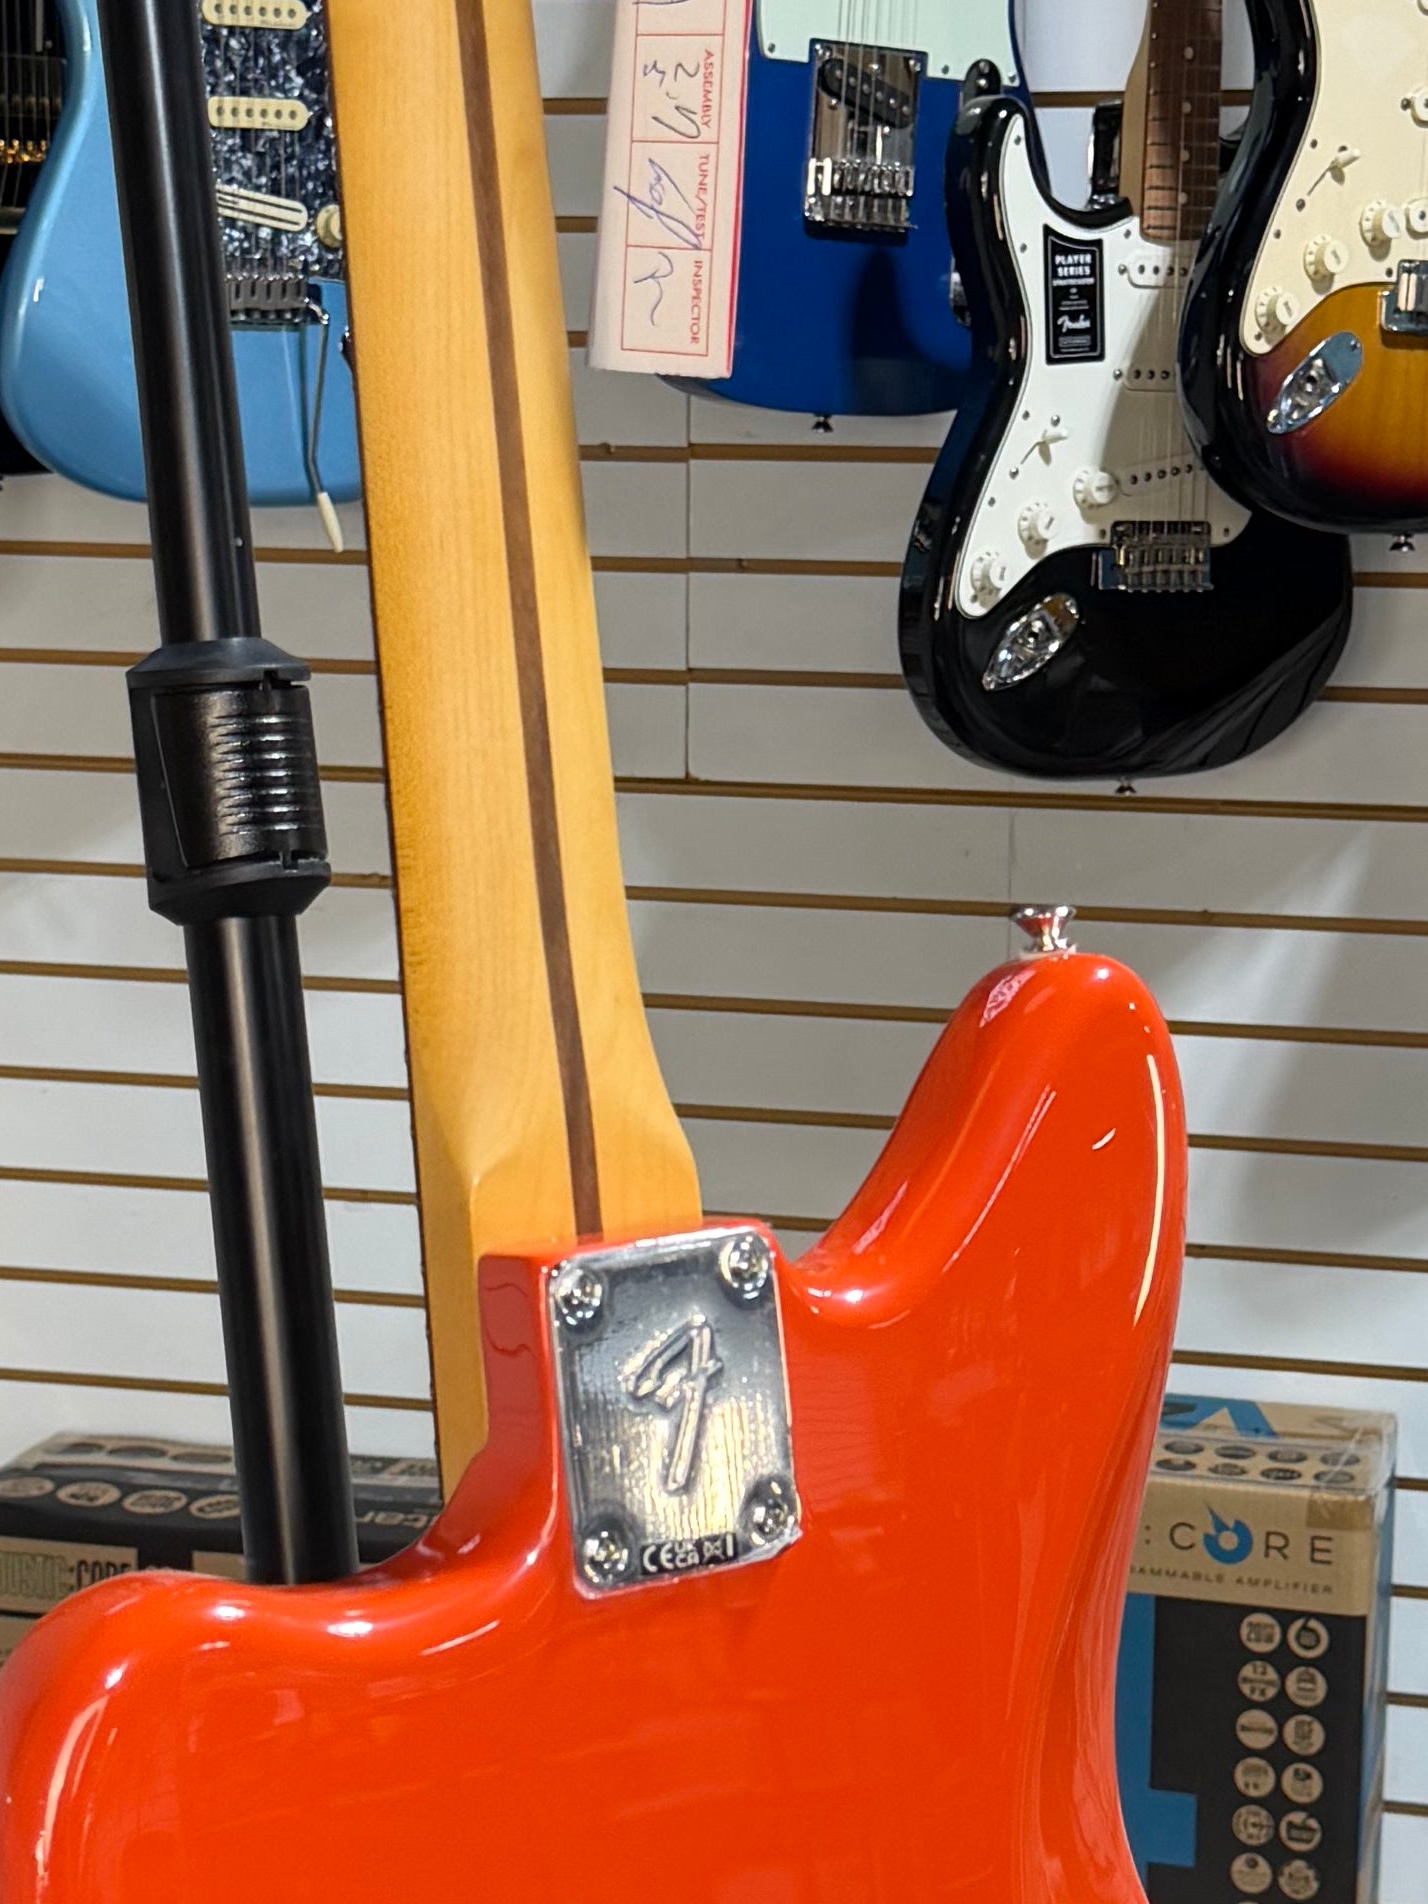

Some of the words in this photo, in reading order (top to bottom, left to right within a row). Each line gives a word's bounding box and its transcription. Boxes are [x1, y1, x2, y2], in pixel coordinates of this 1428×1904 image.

[699, 48, 715, 129] ASSEMBLY
[695, 153, 710, 242] TUNE/TEST
[1054, 253, 1092, 265] PLAYER
[1057, 265, 1091, 277] SERIES
[689, 259, 704, 345] INSPECTOR
[1057, 314, 1091, 333] Fender
[1235, 1576, 1334, 1595] AMPLIFIER
